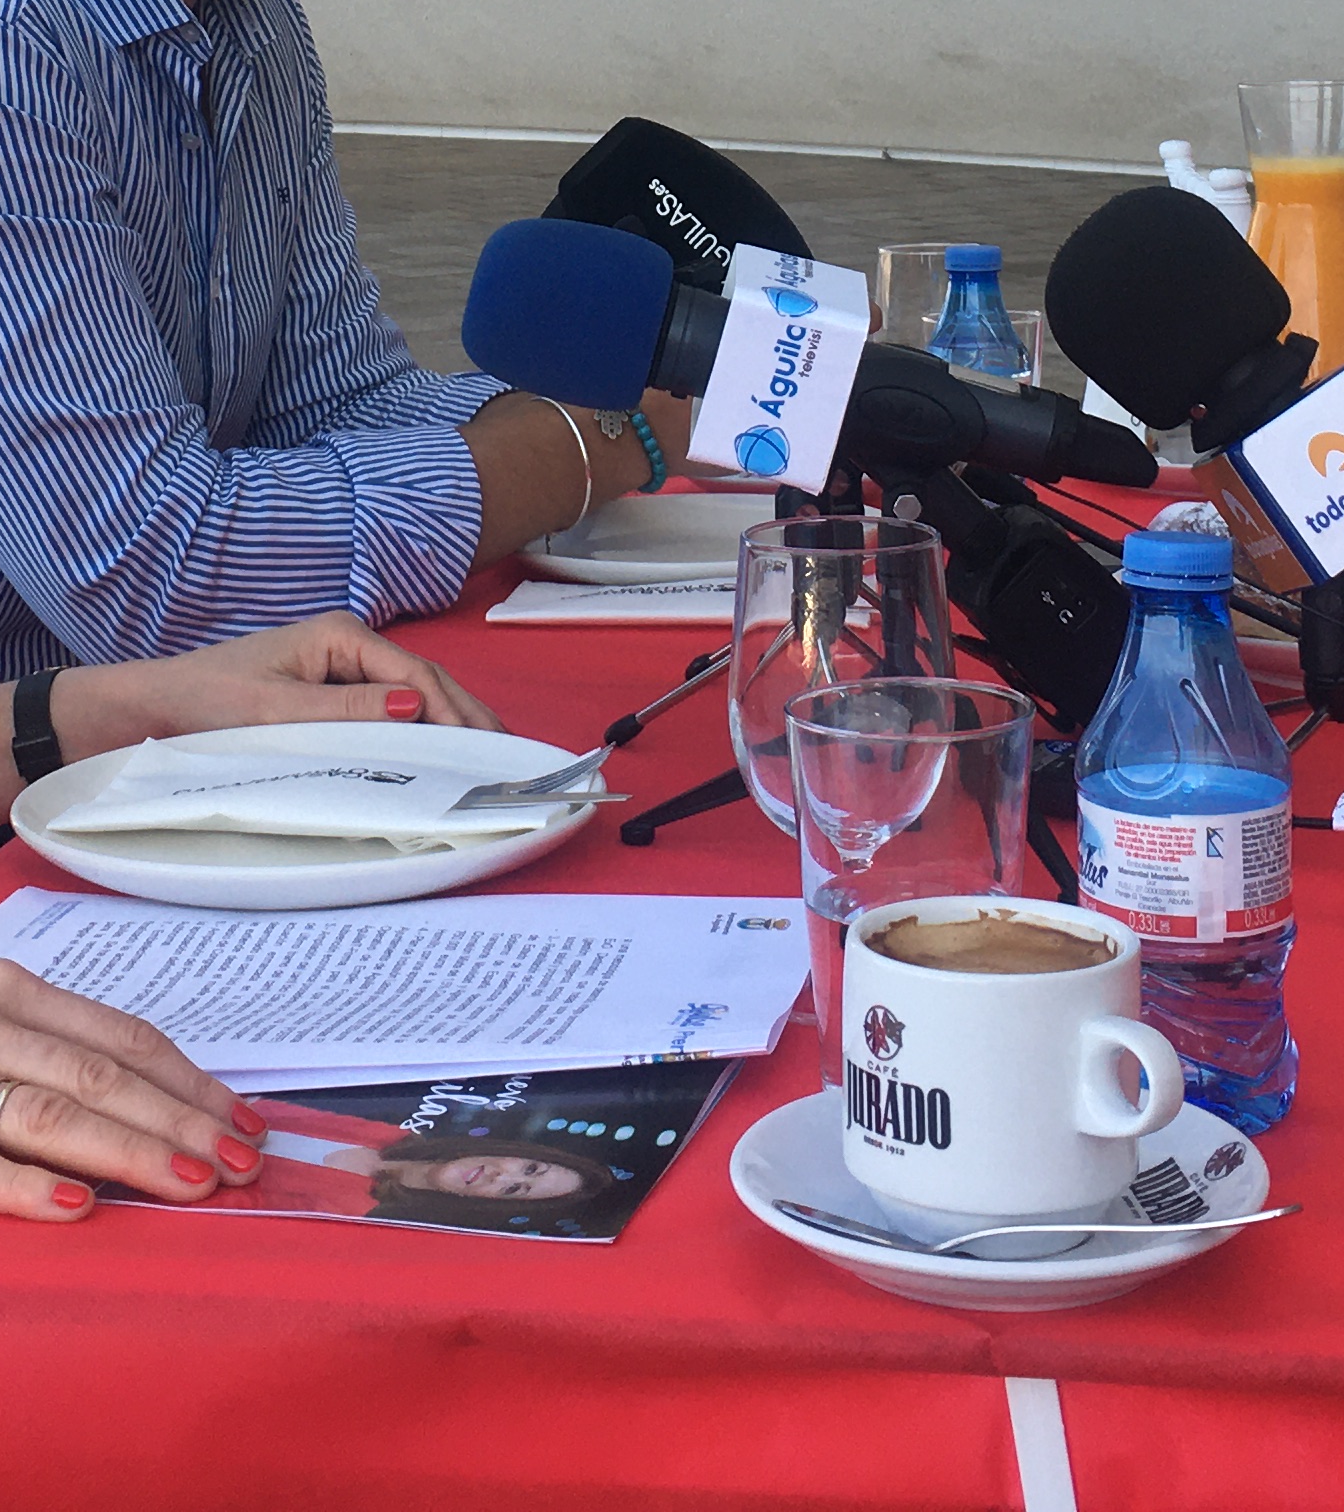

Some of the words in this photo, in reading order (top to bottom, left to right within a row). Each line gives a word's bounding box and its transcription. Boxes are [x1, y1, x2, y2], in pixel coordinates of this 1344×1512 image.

[648, 178, 732, 268] GUILAS.es
[1077, 843, 1108, 889] lus
[1128, 910, 1160, 933] 0.33L
[866, 1059, 899, 1079] CAFÉ
[846, 1058, 952, 1151] JURADO
